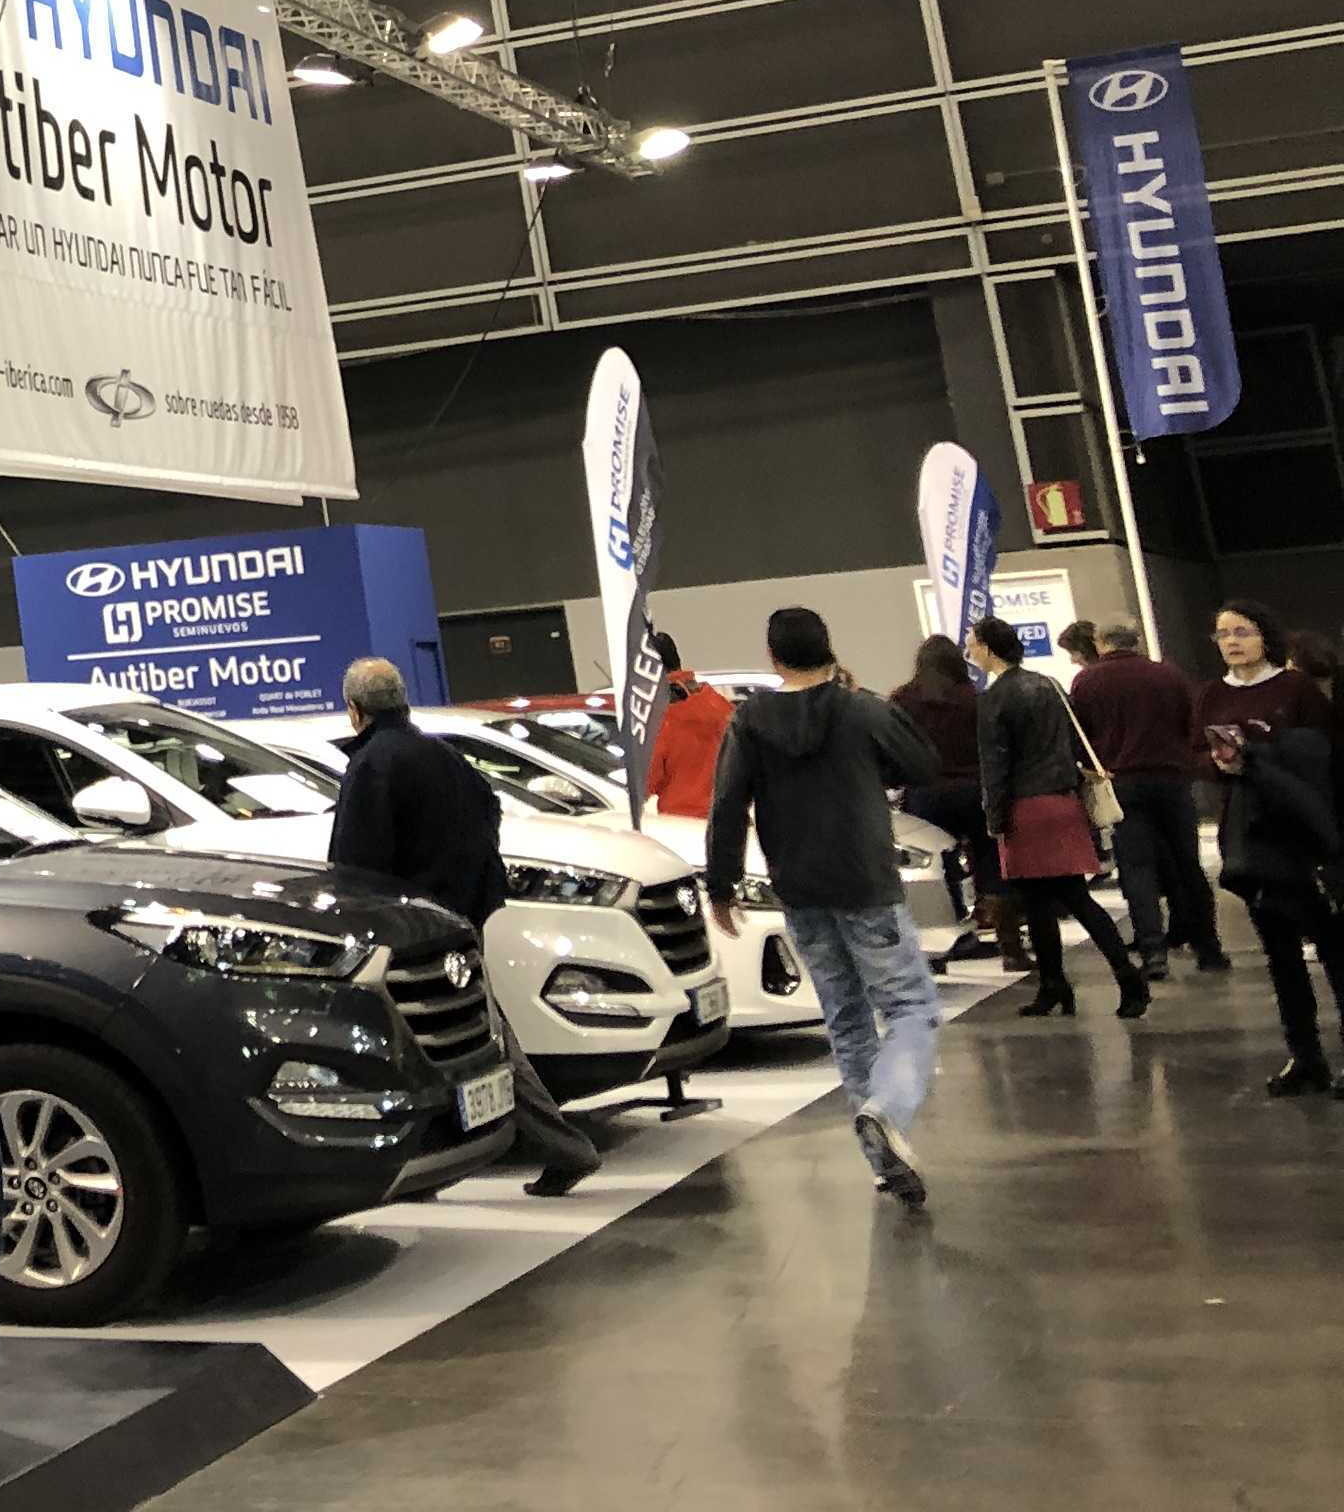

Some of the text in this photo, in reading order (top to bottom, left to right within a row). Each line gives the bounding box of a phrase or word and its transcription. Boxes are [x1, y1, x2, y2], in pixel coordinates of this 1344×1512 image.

[134, 113, 273, 247] Motor
[52, 227, 126, 276] HYUNDAI
[129, 246, 185, 289] NUNCA
[1112, 131, 1210, 416] HYUNDAI
[129, 545, 305, 590] HYUNDAI
[145, 591, 271, 626] PROMISE
[172, 621, 249, 638] SEMINUEVOS
[89, 654, 307, 693] Autiber Motor
